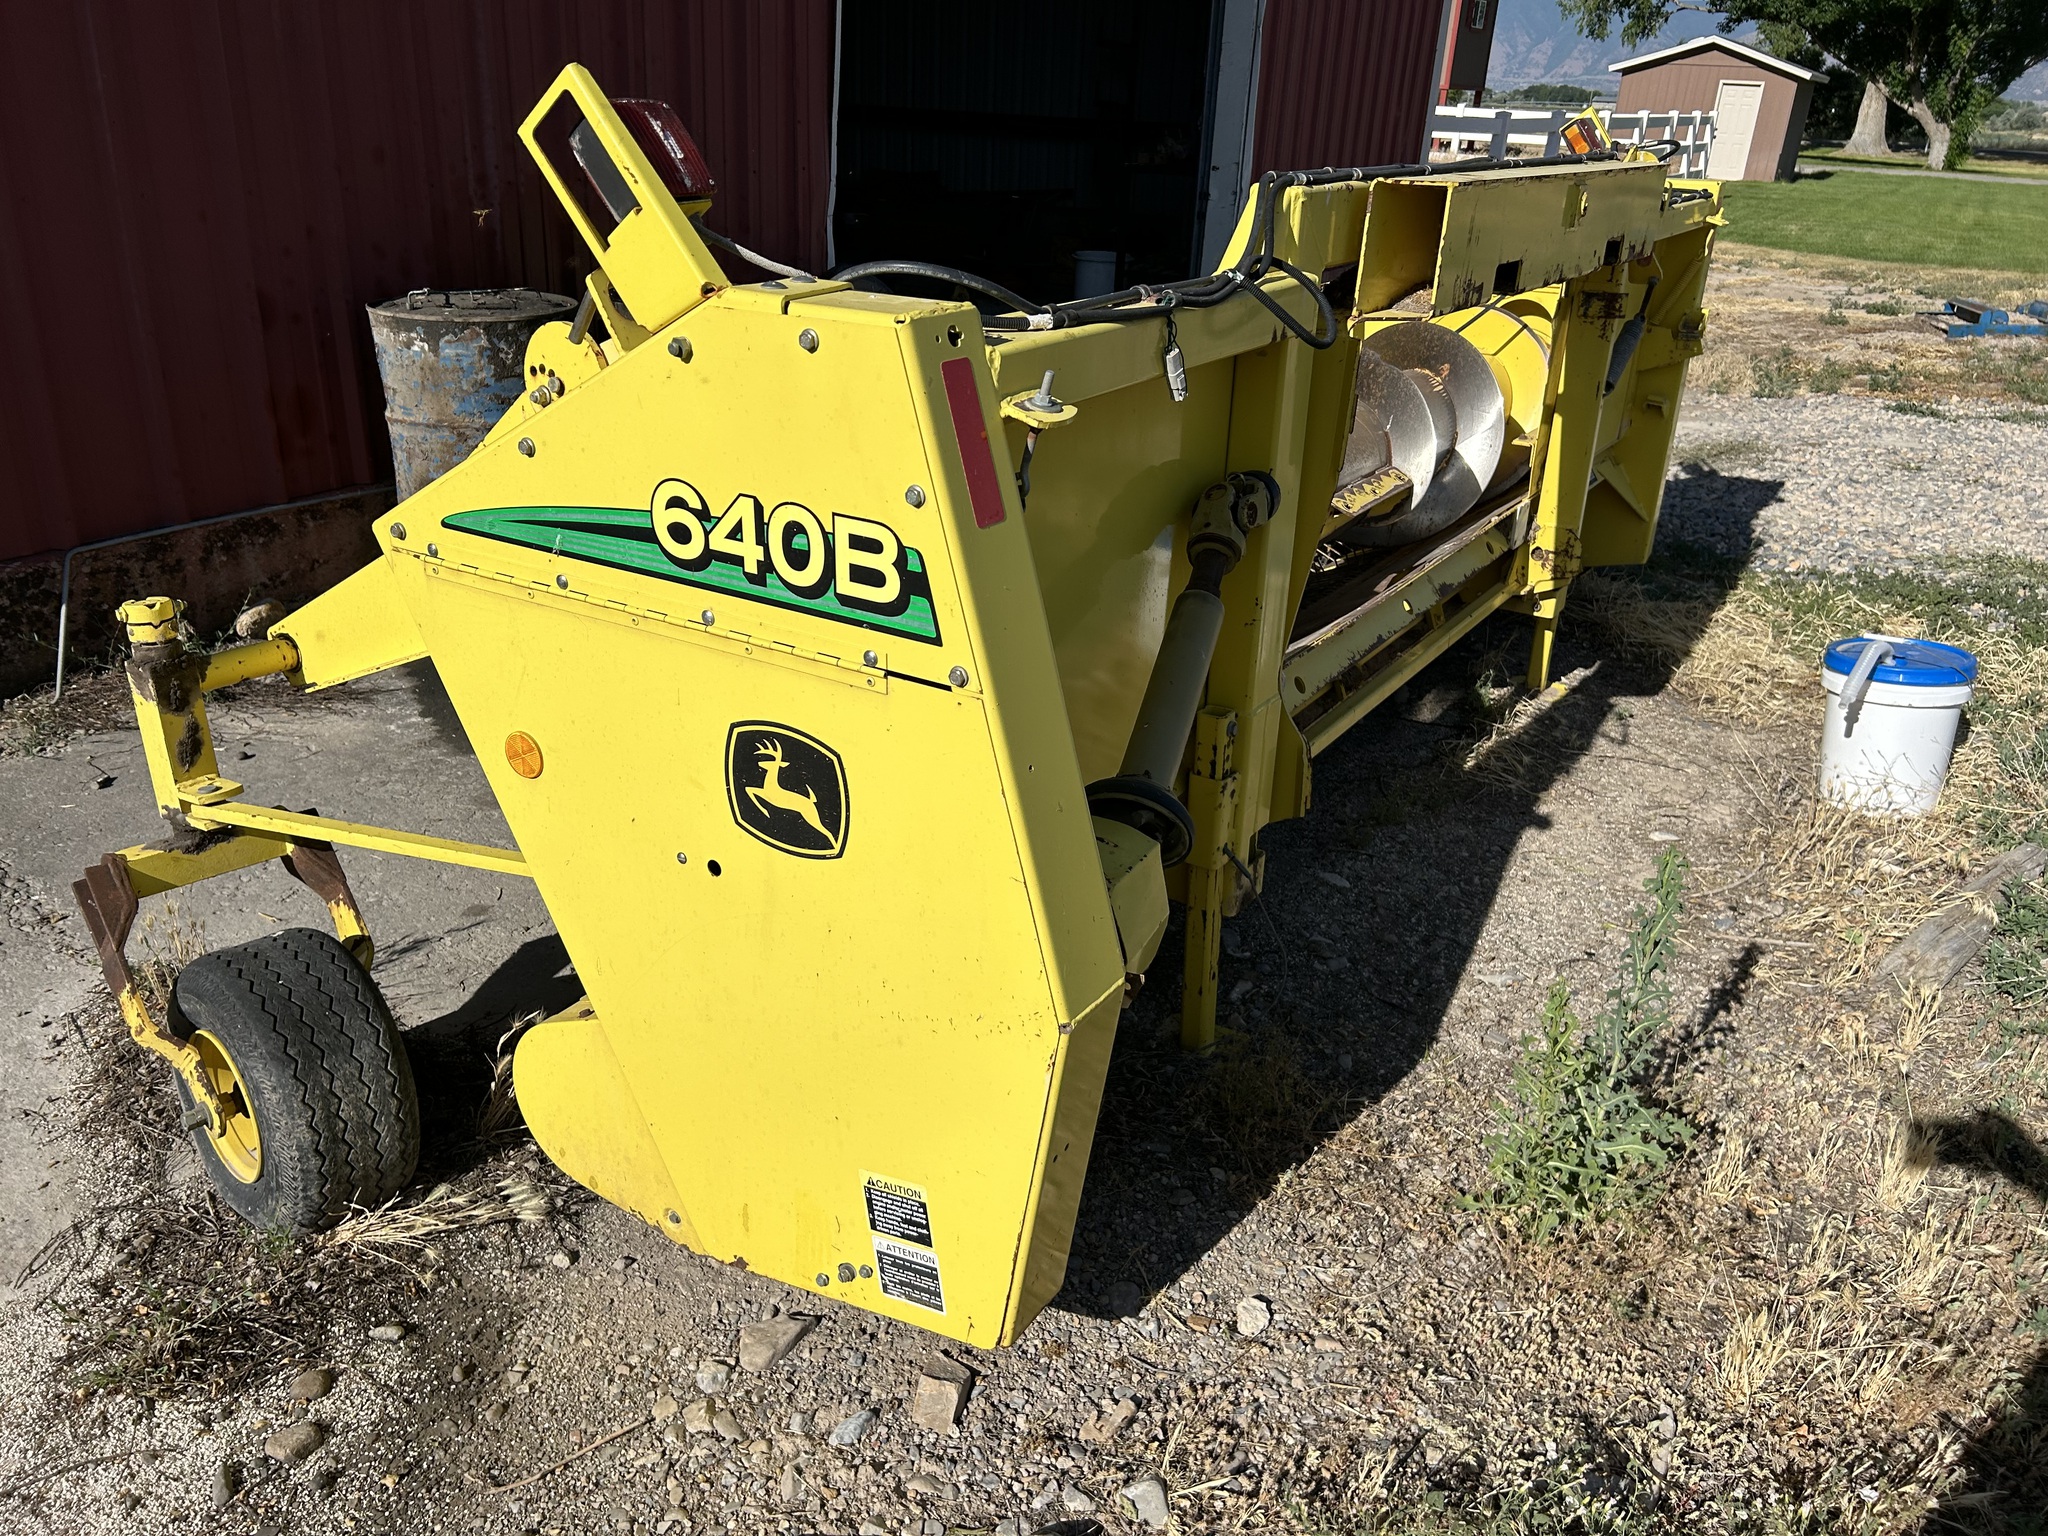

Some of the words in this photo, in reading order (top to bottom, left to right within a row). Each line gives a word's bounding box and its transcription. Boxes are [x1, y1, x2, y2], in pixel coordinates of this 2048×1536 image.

[650, 477, 910, 617] 640B
[876, 1179, 922, 1199] CAUTION
[886, 1243, 935, 1265] ATTENTION
